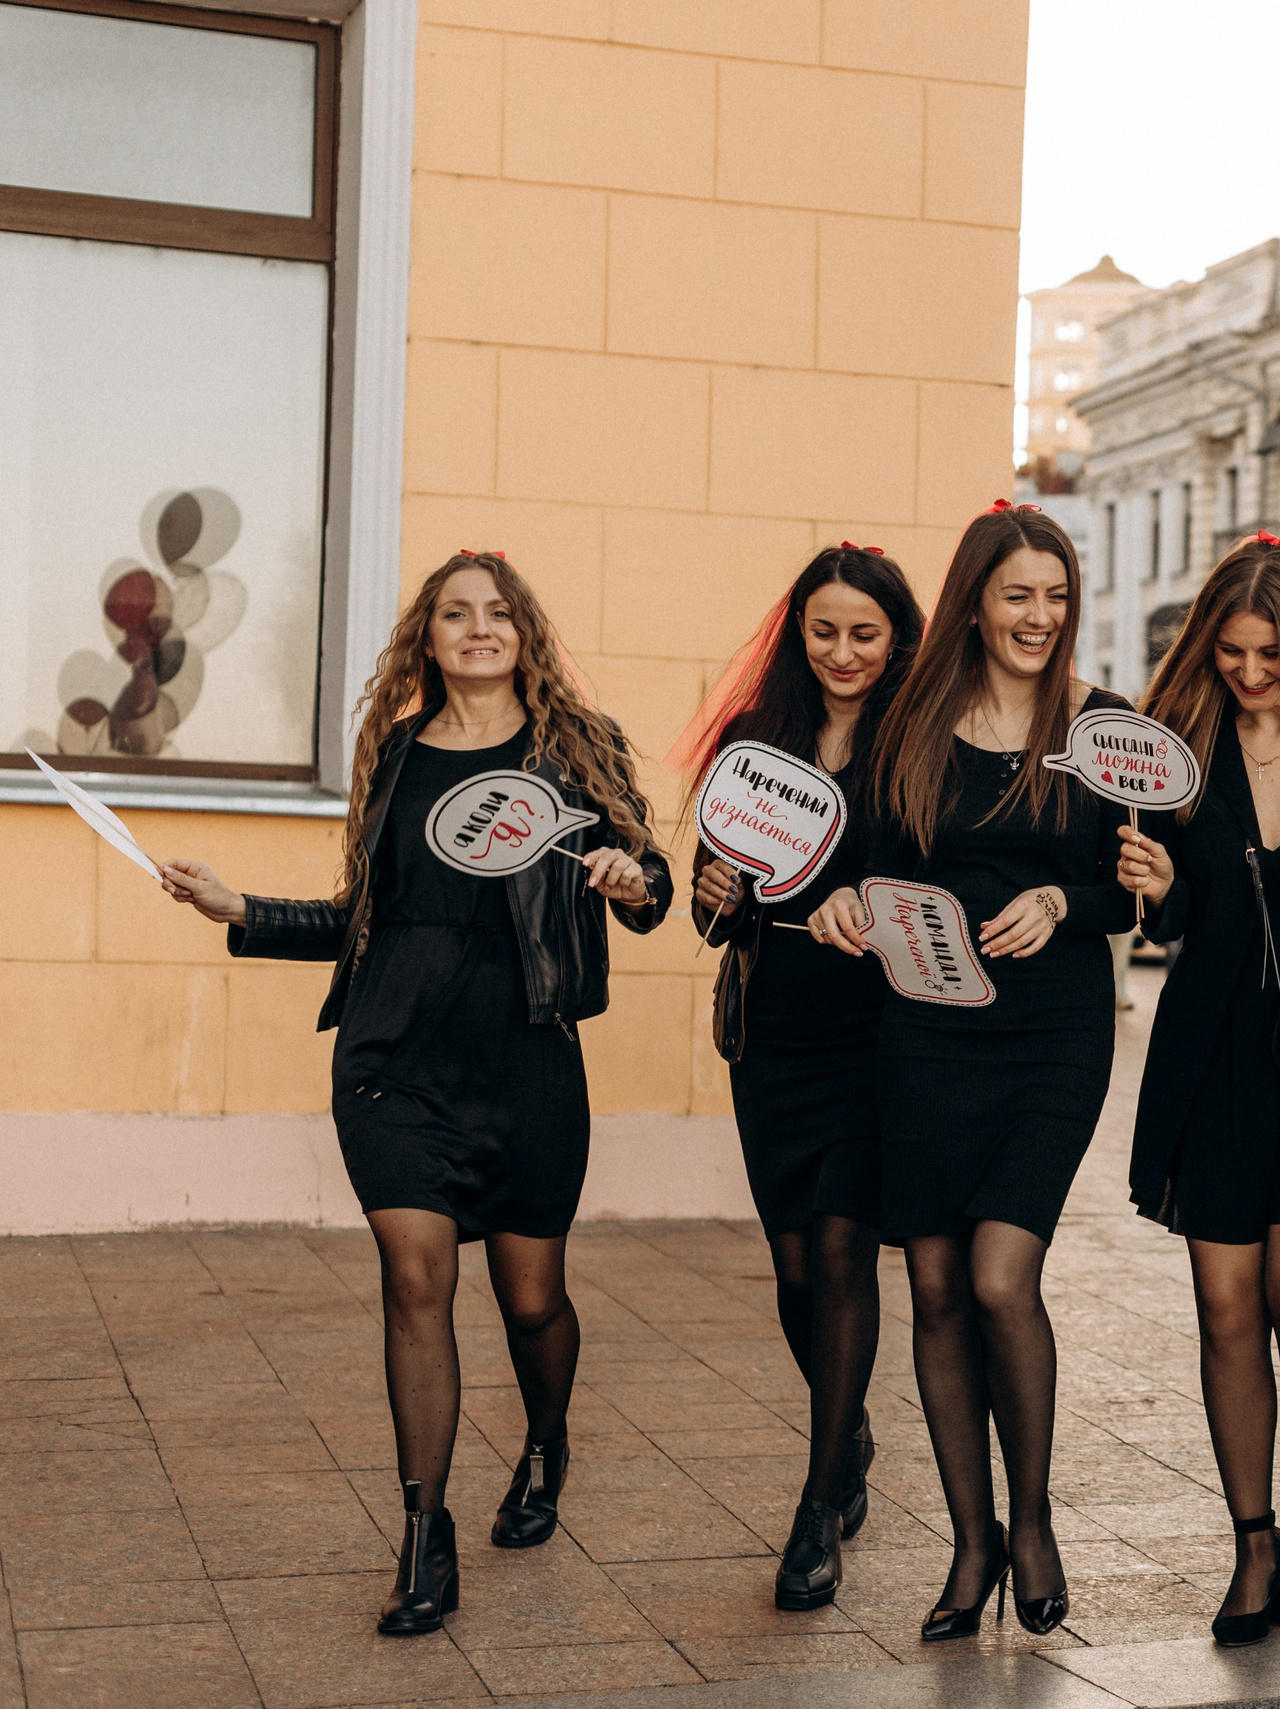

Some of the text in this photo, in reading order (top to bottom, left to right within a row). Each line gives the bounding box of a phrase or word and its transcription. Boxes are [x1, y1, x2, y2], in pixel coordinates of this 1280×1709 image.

[731, 755, 829, 818] Наречений
[746, 791, 788, 820] не
[705, 797, 814, 856] дізнається
[888, 892, 938, 979] Нареченої
[920, 902, 962, 982] КОМАНДА
